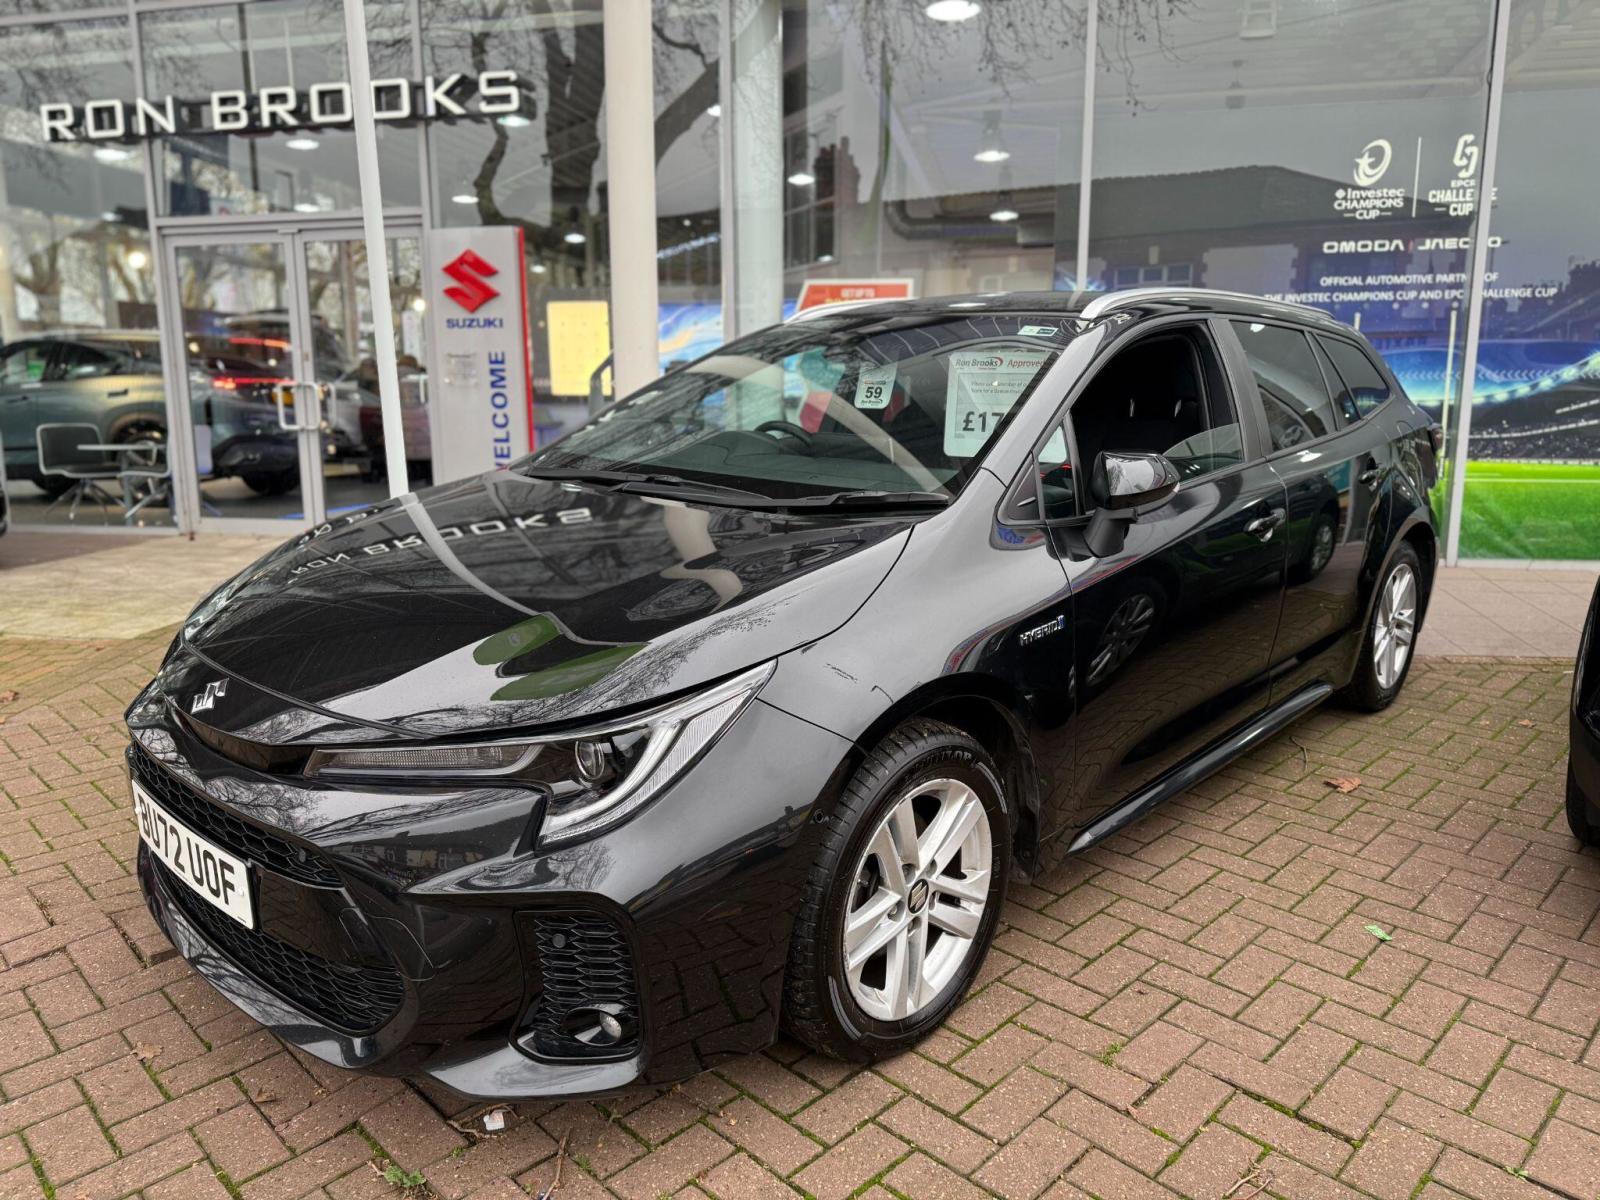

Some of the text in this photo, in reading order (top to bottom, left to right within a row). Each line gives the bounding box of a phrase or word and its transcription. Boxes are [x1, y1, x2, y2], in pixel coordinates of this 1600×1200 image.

[40, 70, 520, 140] RON BROOKS
[1347, 187, 1405, 199] Investec
[1428, 187, 1498, 203] CHALLEE
[1333, 198, 1404, 210] CHAMPIONS
[1449, 203, 1474, 216] CUP
[1355, 209, 1380, 220] CUP
[1323, 239, 1405, 254] OMODA
[1417, 236, 1501, 250] JAECO
[1320, 276, 1363, 287] OFFICIAL
[1365, 273, 1433, 286] AUTOMOTIVE
[1484, 272, 1499, 282] OF
[1285, 292, 1331, 303] INVESTEC
[1332, 290, 1394, 302] CHAMPIONS
[1396, 290, 1418, 300] CUP
[1419, 289, 1442, 299] AND
[1535, 287, 1558, 297] CUP
[446, 317, 504, 329] SUZUKI
[955, 358, 970, 367] Ron
[971, 358, 998, 367] Brooks
[865, 386, 883, 399] 59
[1020, 620, 1058, 647] HYBRID
[137, 792, 236, 906] BU72 UOF
